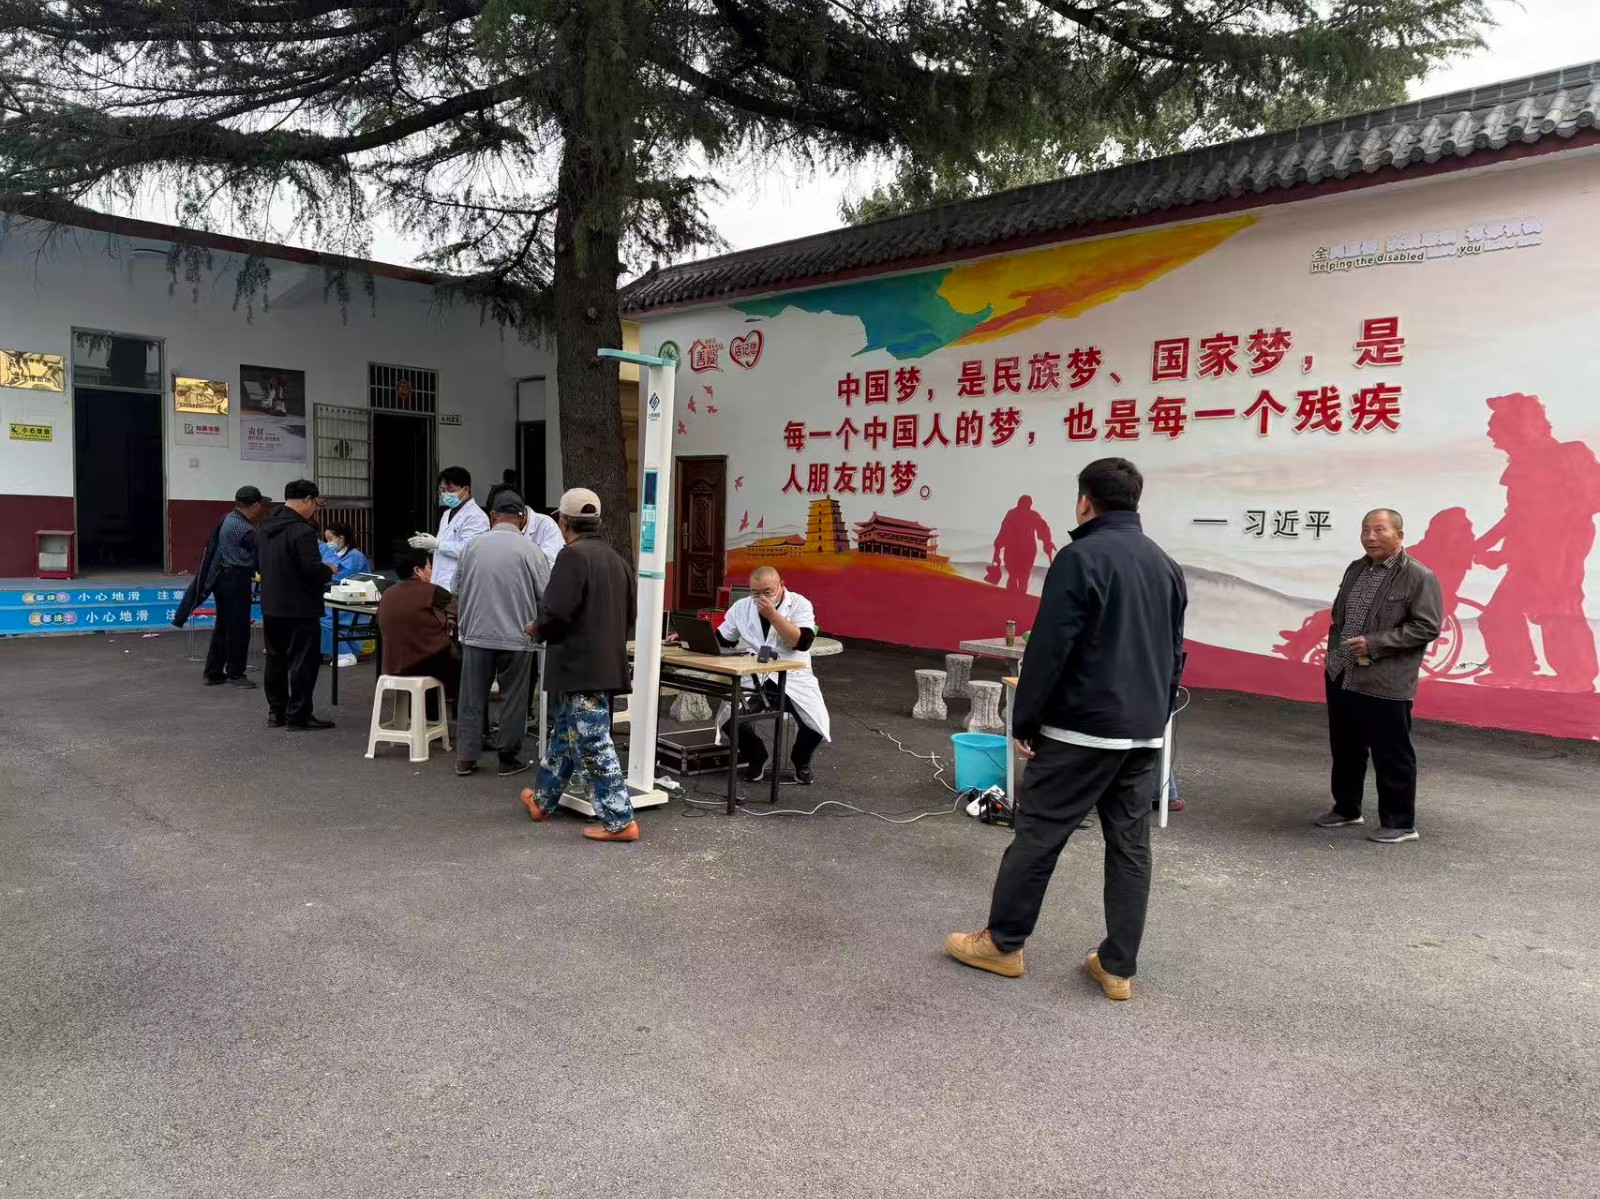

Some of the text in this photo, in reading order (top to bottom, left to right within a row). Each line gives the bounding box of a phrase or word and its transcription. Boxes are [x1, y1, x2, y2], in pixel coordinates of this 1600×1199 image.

[1312, 259, 1353, 272] Helping
[1356, 256, 1374, 266] the
[1377, 251, 1425, 262] disabled
[1460, 244, 1481, 254] you
[781, 460, 930, 498] 人朋友的梦。
[1244, 508, 1333, 539] 习近平
[78, 591, 140, 601] 小心地滑
[86, 610, 149, 622] 小心地滑
